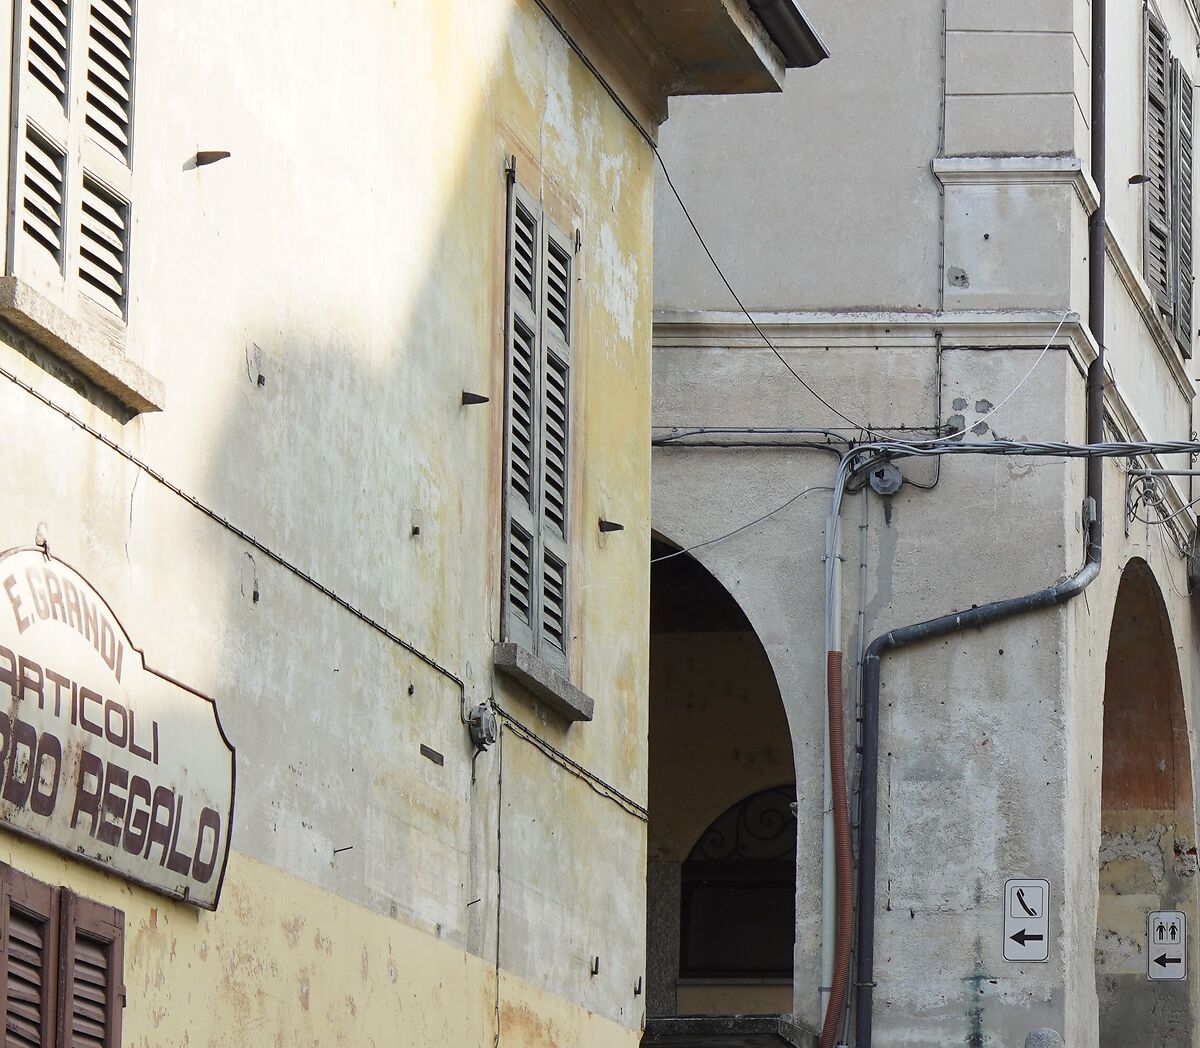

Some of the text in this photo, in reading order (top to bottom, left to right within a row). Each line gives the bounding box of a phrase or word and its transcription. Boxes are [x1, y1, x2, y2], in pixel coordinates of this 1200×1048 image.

[0, 645, 159, 766] ARTICOLI
[0, 711, 221, 884] DO REGALO
